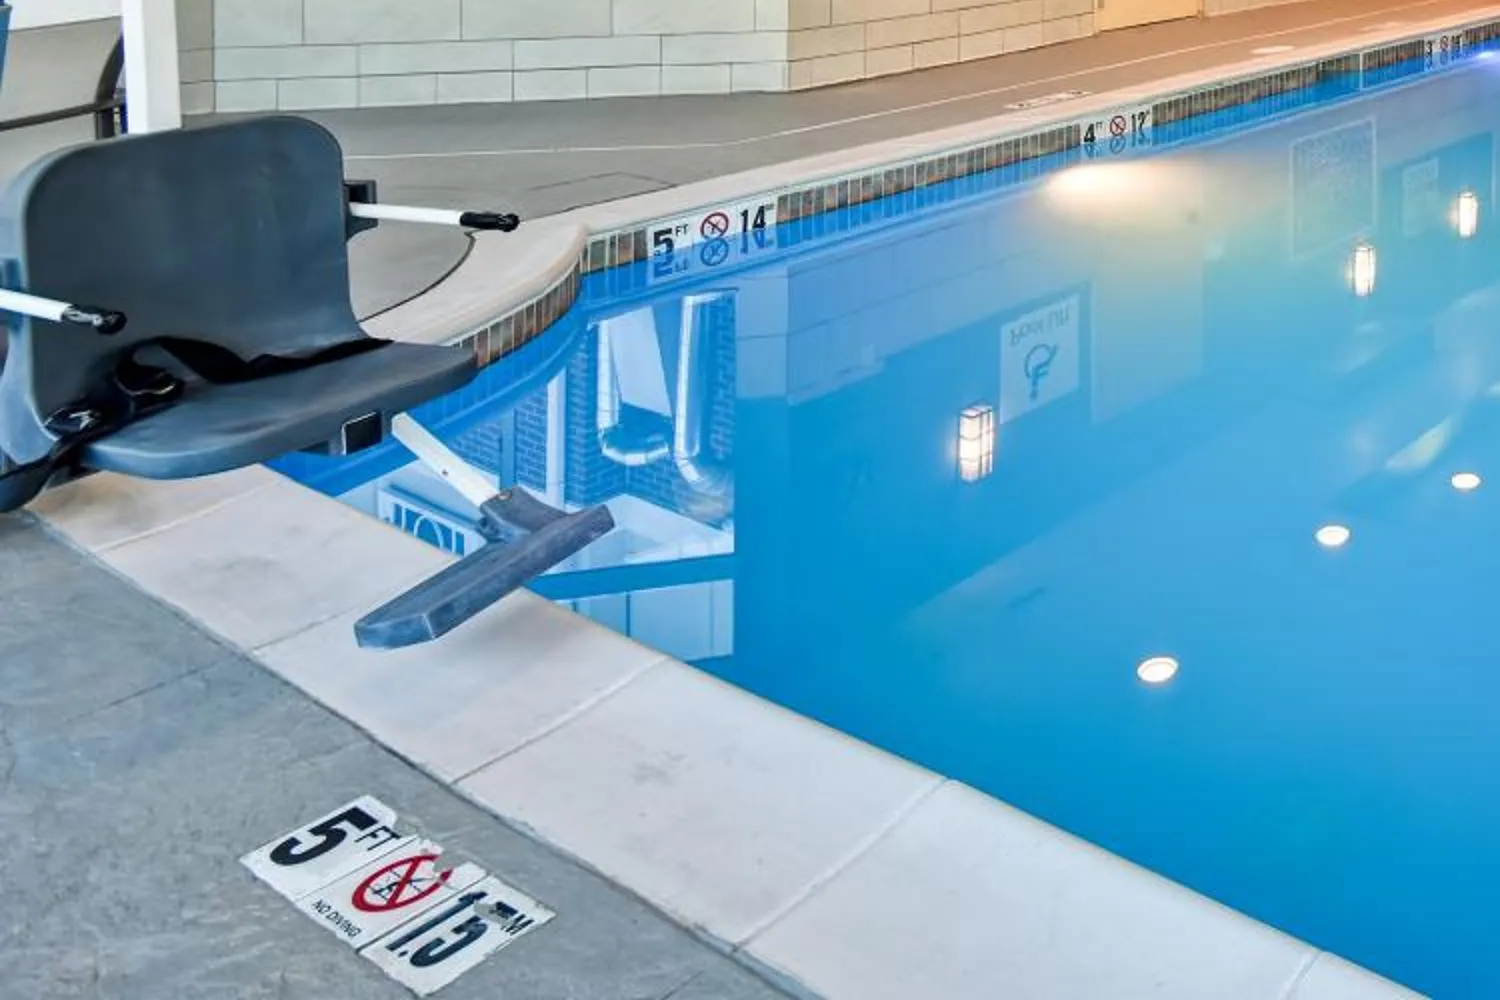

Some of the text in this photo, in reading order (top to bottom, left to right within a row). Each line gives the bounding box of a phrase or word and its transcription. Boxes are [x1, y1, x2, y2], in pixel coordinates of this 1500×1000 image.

[1083, 123, 1096, 143] 4
[653, 228, 674, 256] 5
[675, 224, 689, 237] FT
[269, 806, 402, 867] 5 FT
[311, 899, 362, 938] NO DIVING
